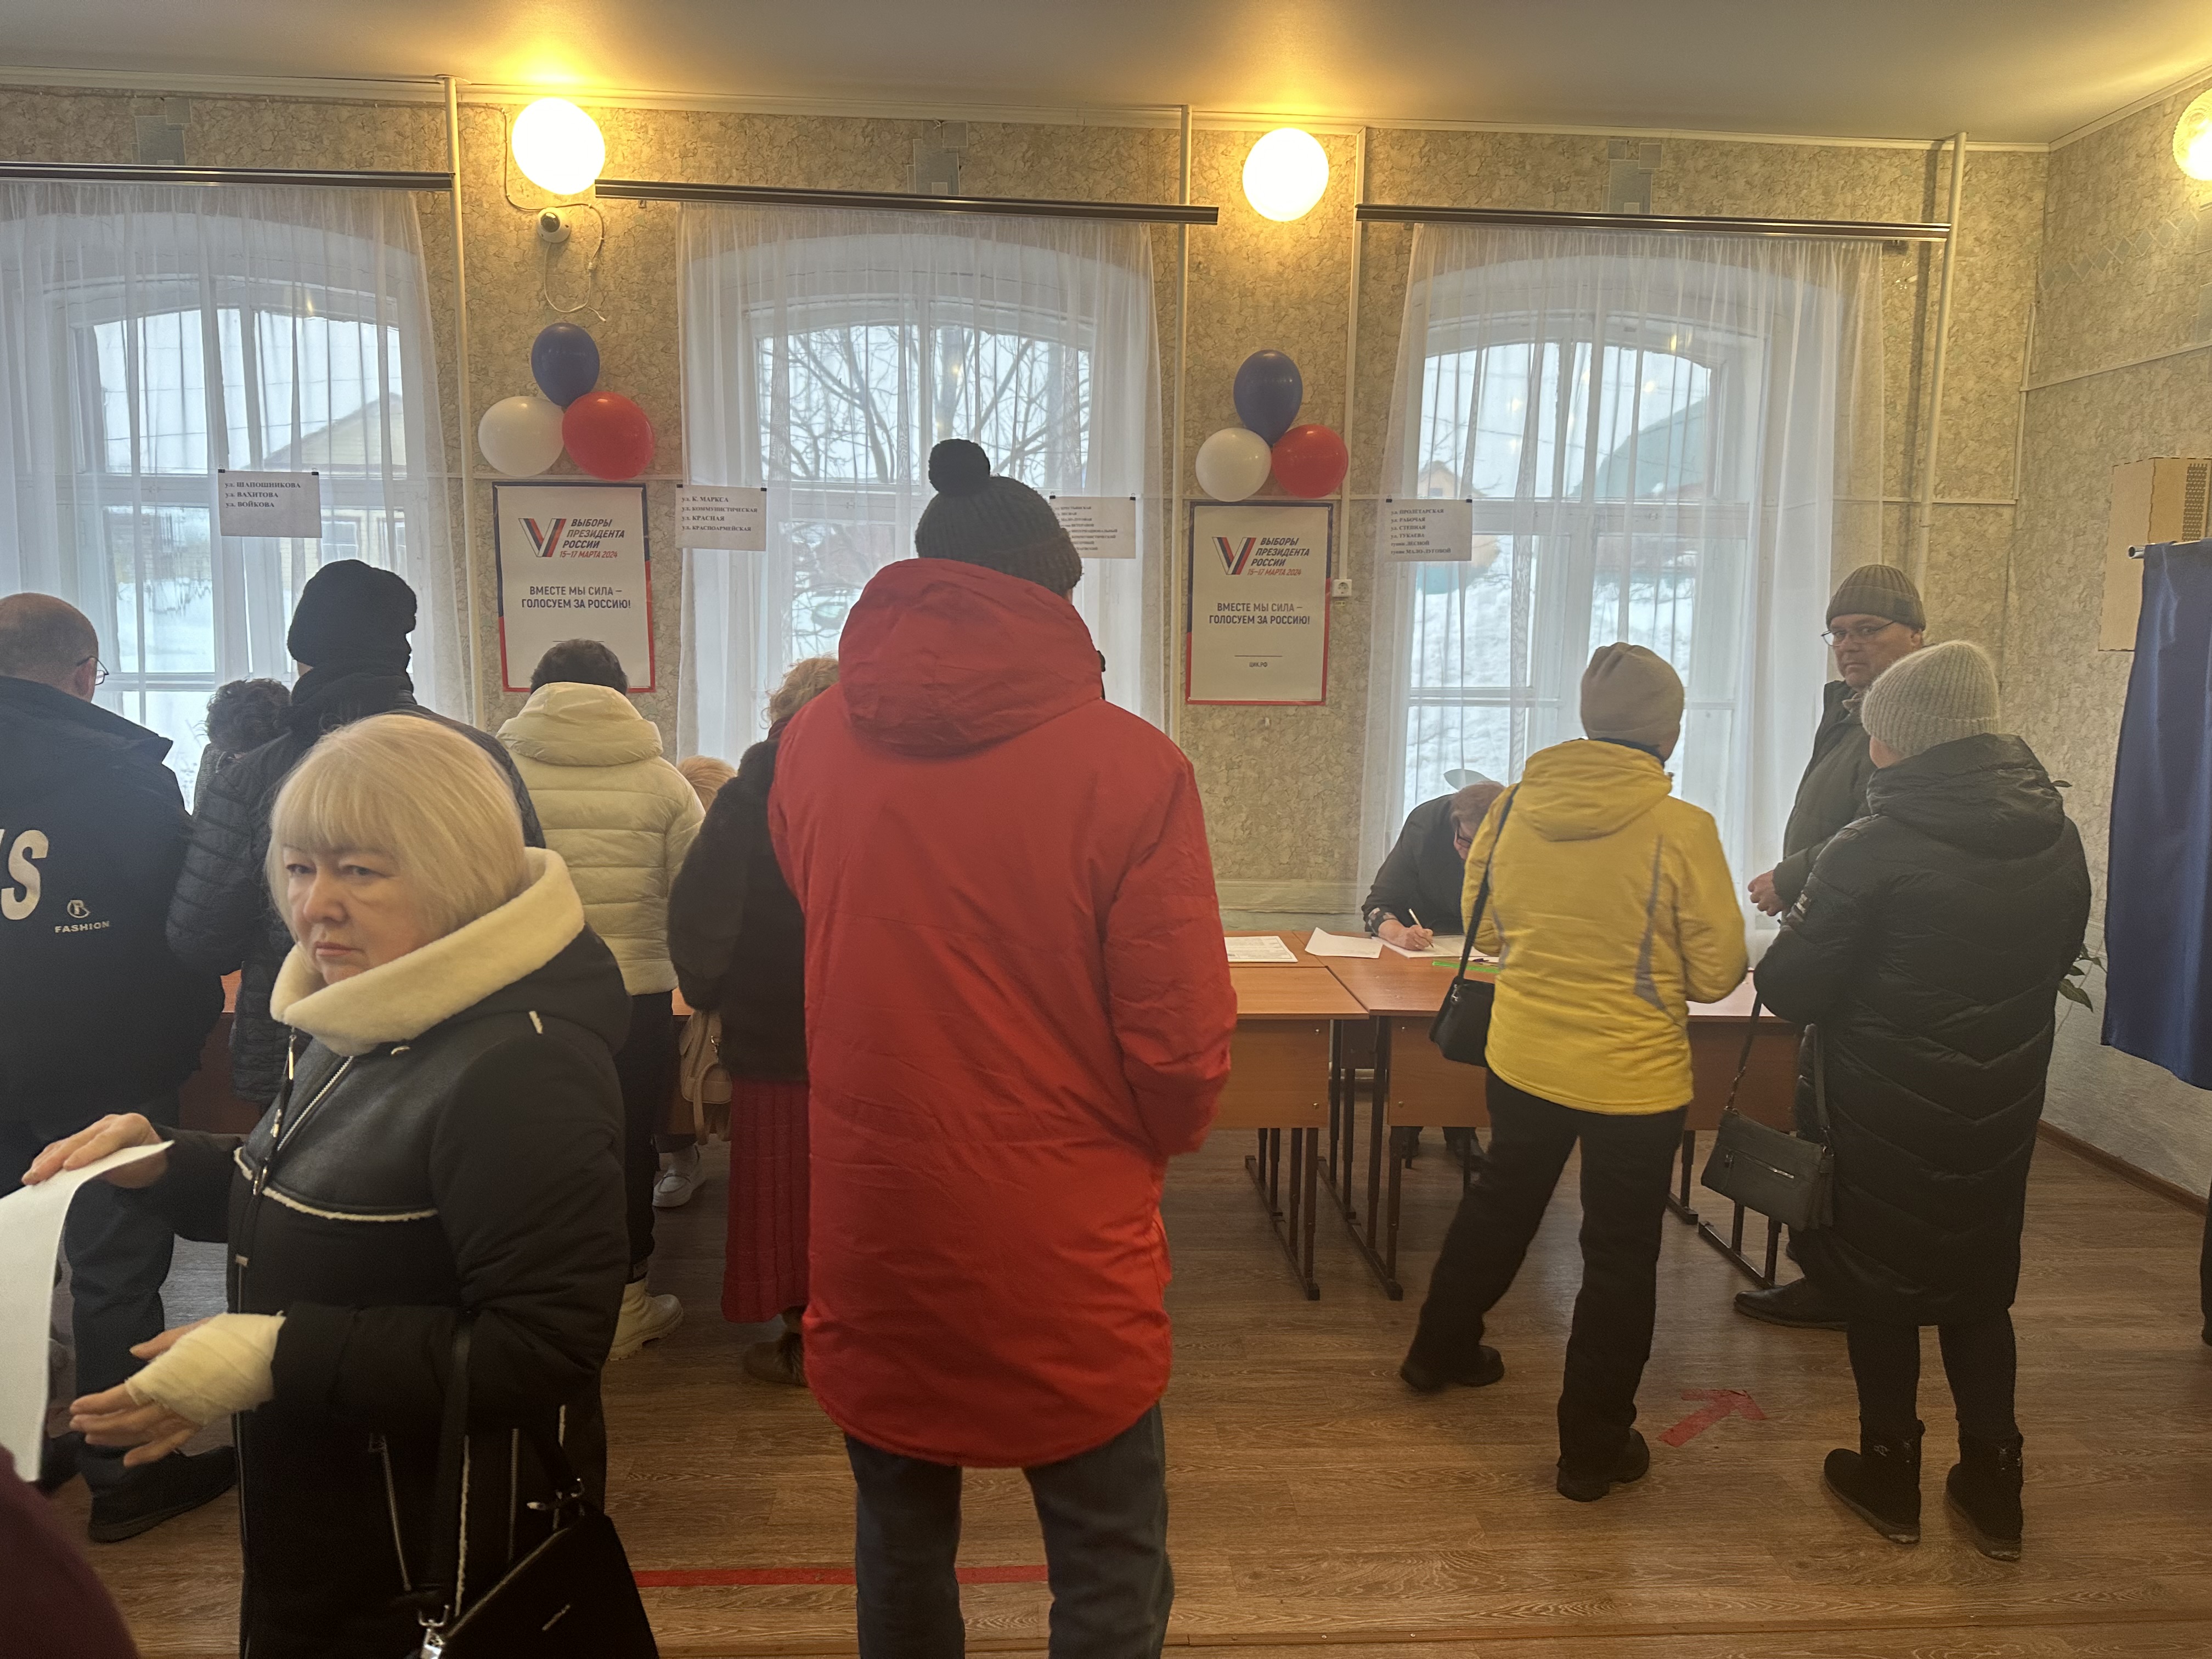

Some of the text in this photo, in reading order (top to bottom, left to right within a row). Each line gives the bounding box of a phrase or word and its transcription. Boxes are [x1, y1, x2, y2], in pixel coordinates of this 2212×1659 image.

[571, 519, 612, 527] ВЫБОРЫ
[567, 530, 625, 538] ПРЕЗИДЕНТА
[562, 540, 600, 549] РОССИИ
[1260, 538, 1299, 546] ВЫБОРЫ
[1251, 558, 1286, 567] РОССИИ
[530, 586, 566, 595] ВМЕСТЕ
[569, 587, 585, 595] МЫ
[588, 587, 613, 595] СИЛА
[522, 599, 631, 608] ГОЛОСУЕМ ЗА РОССИЮ!
[1217, 603, 1251, 612] ВМЕСТЕ
[1253, 603, 1269, 612] МЫ
[1271, 603, 1294, 612] СИЛА
[1209, 615, 1310, 624] ГОЛОСУЕМ ЗА РОССИЮ!
[54, 921, 110, 933] FASHION
